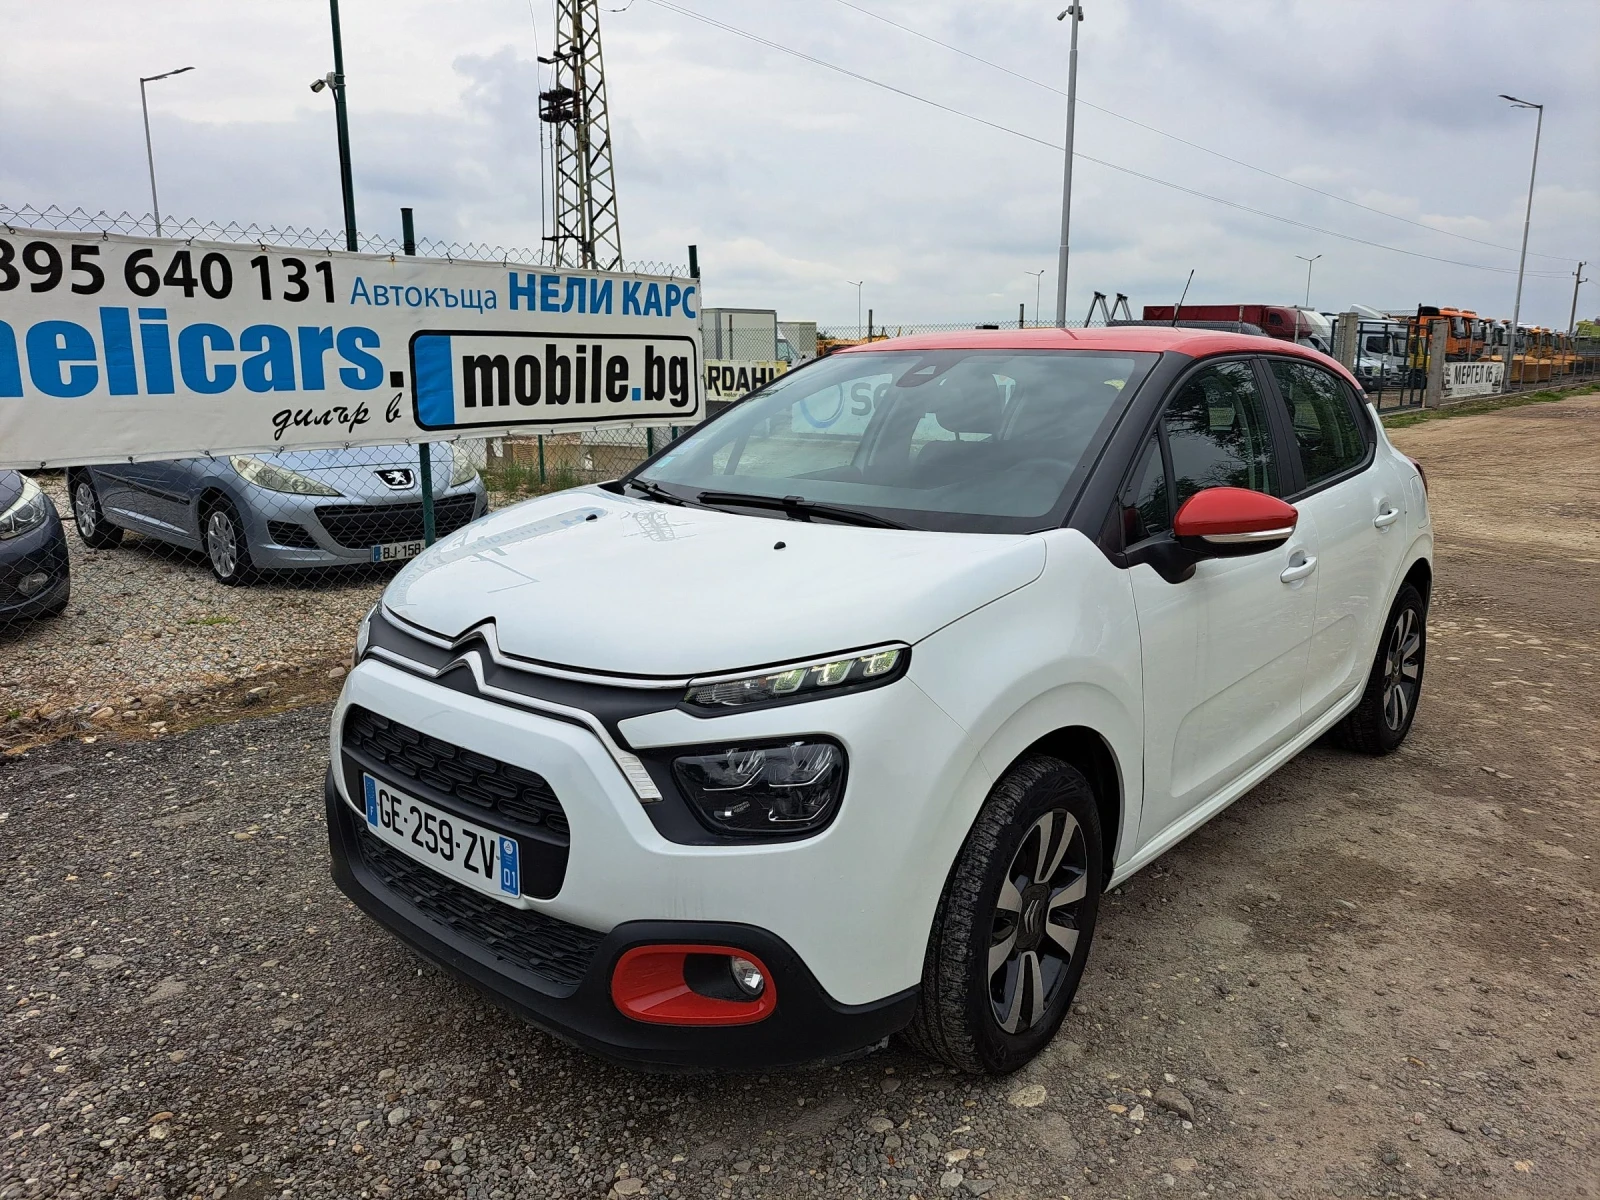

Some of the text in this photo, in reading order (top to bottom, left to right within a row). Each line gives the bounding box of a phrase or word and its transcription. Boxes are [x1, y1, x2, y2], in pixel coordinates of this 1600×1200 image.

[124, 248, 234, 300] 640
[250, 255, 335, 303] 131
[350, 272, 697, 319] Автокъща НЕЛИ КАРС
[462, 343, 688, 408] mobile.bg
[272, 402, 371, 441] дилър
[379, 789, 495, 879] GE-259-ZV
[504, 867, 516, 889] 01
